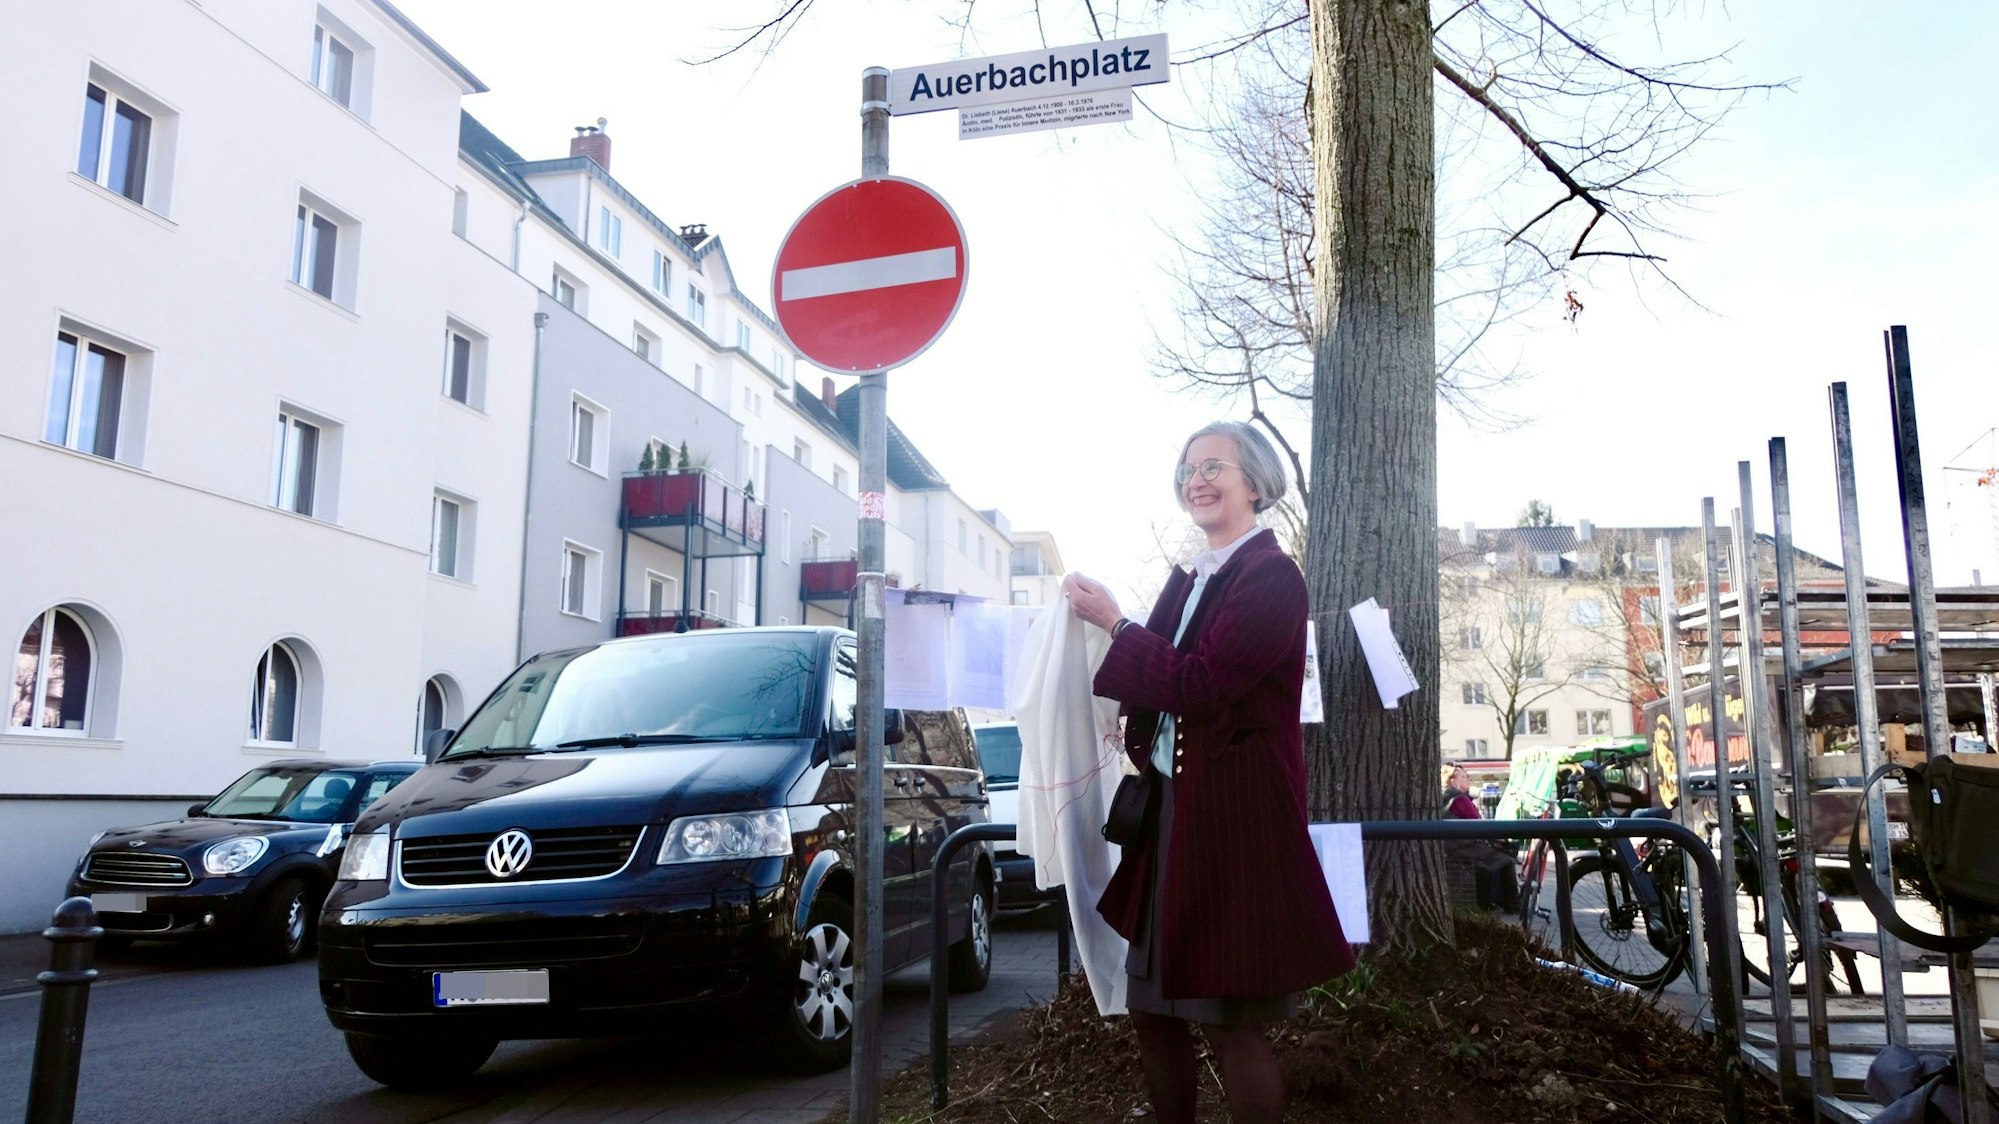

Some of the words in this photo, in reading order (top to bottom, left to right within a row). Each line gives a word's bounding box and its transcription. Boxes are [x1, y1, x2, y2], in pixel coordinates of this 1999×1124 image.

[909, 44, 1151, 102] Auerbachplatz
[992, 108, 1010, 116] (Liese)
[1011, 105, 1037, 113] Auerbach
